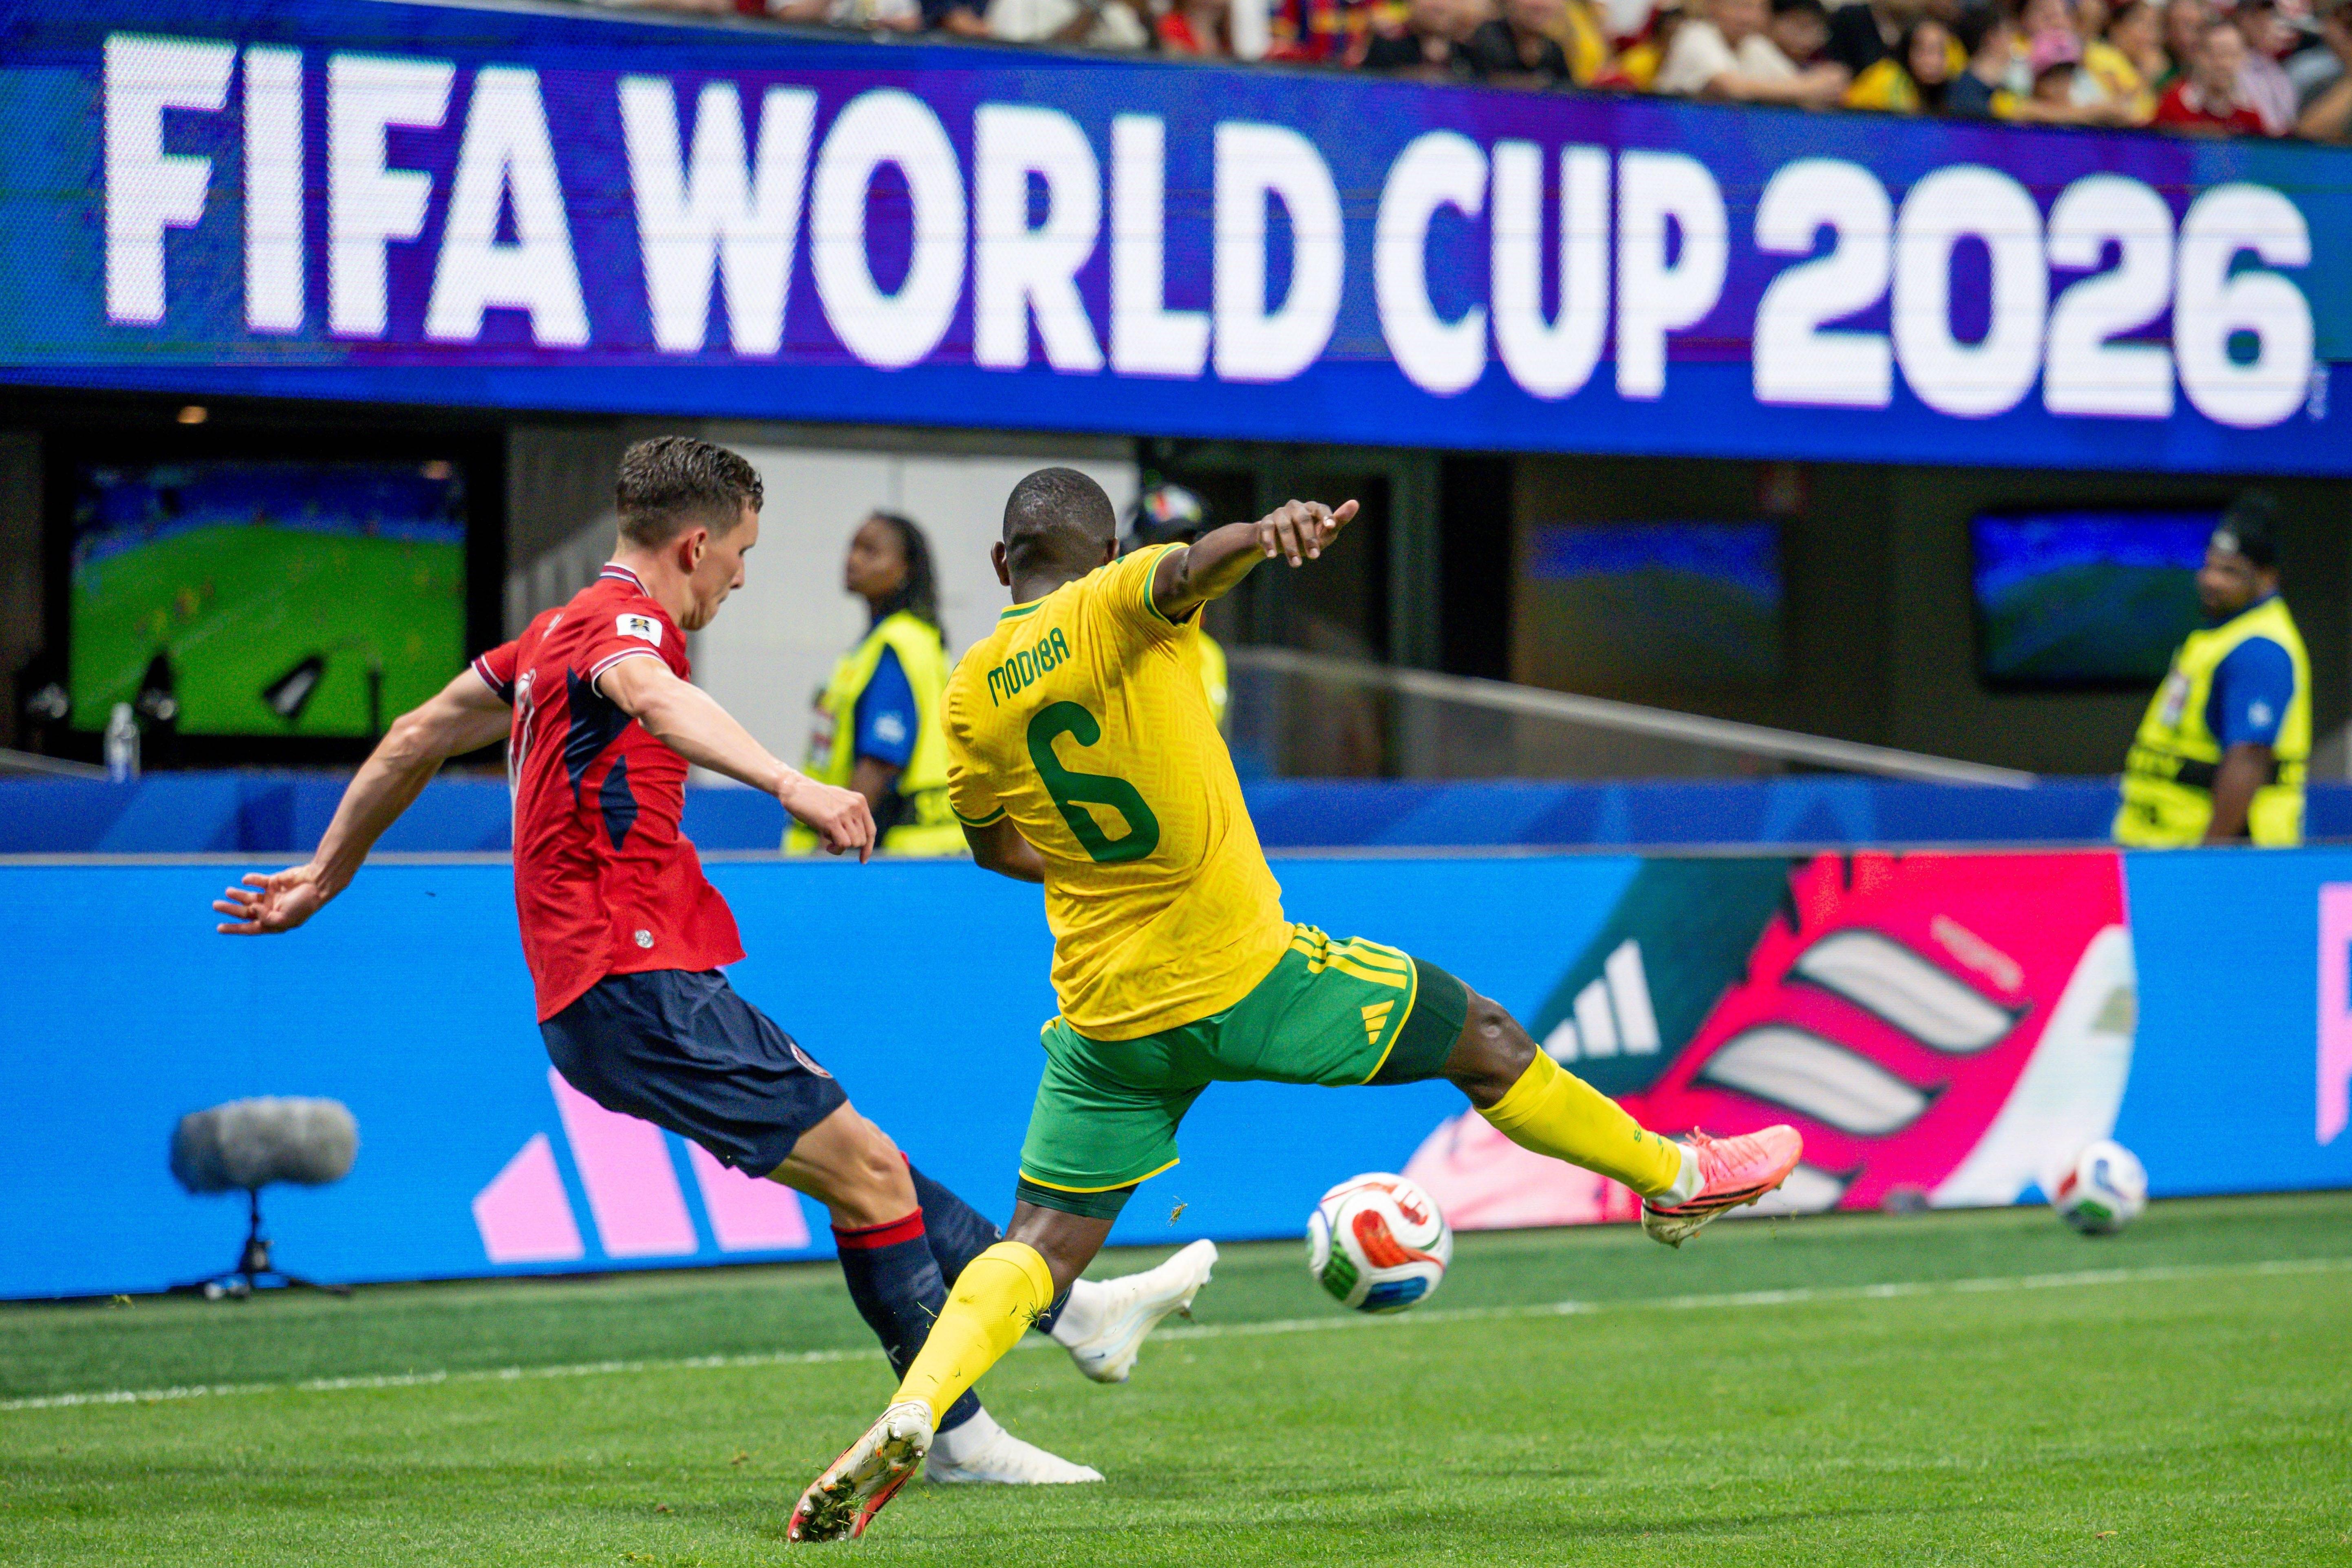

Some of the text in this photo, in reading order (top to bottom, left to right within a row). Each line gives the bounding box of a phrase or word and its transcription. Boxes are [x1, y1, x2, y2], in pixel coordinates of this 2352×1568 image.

[104, 37, 2314, 426] FIFA WORLD CUP 2026
[987, 627, 1070, 708] MODIBA
[1027, 701, 1160, 863] 6
